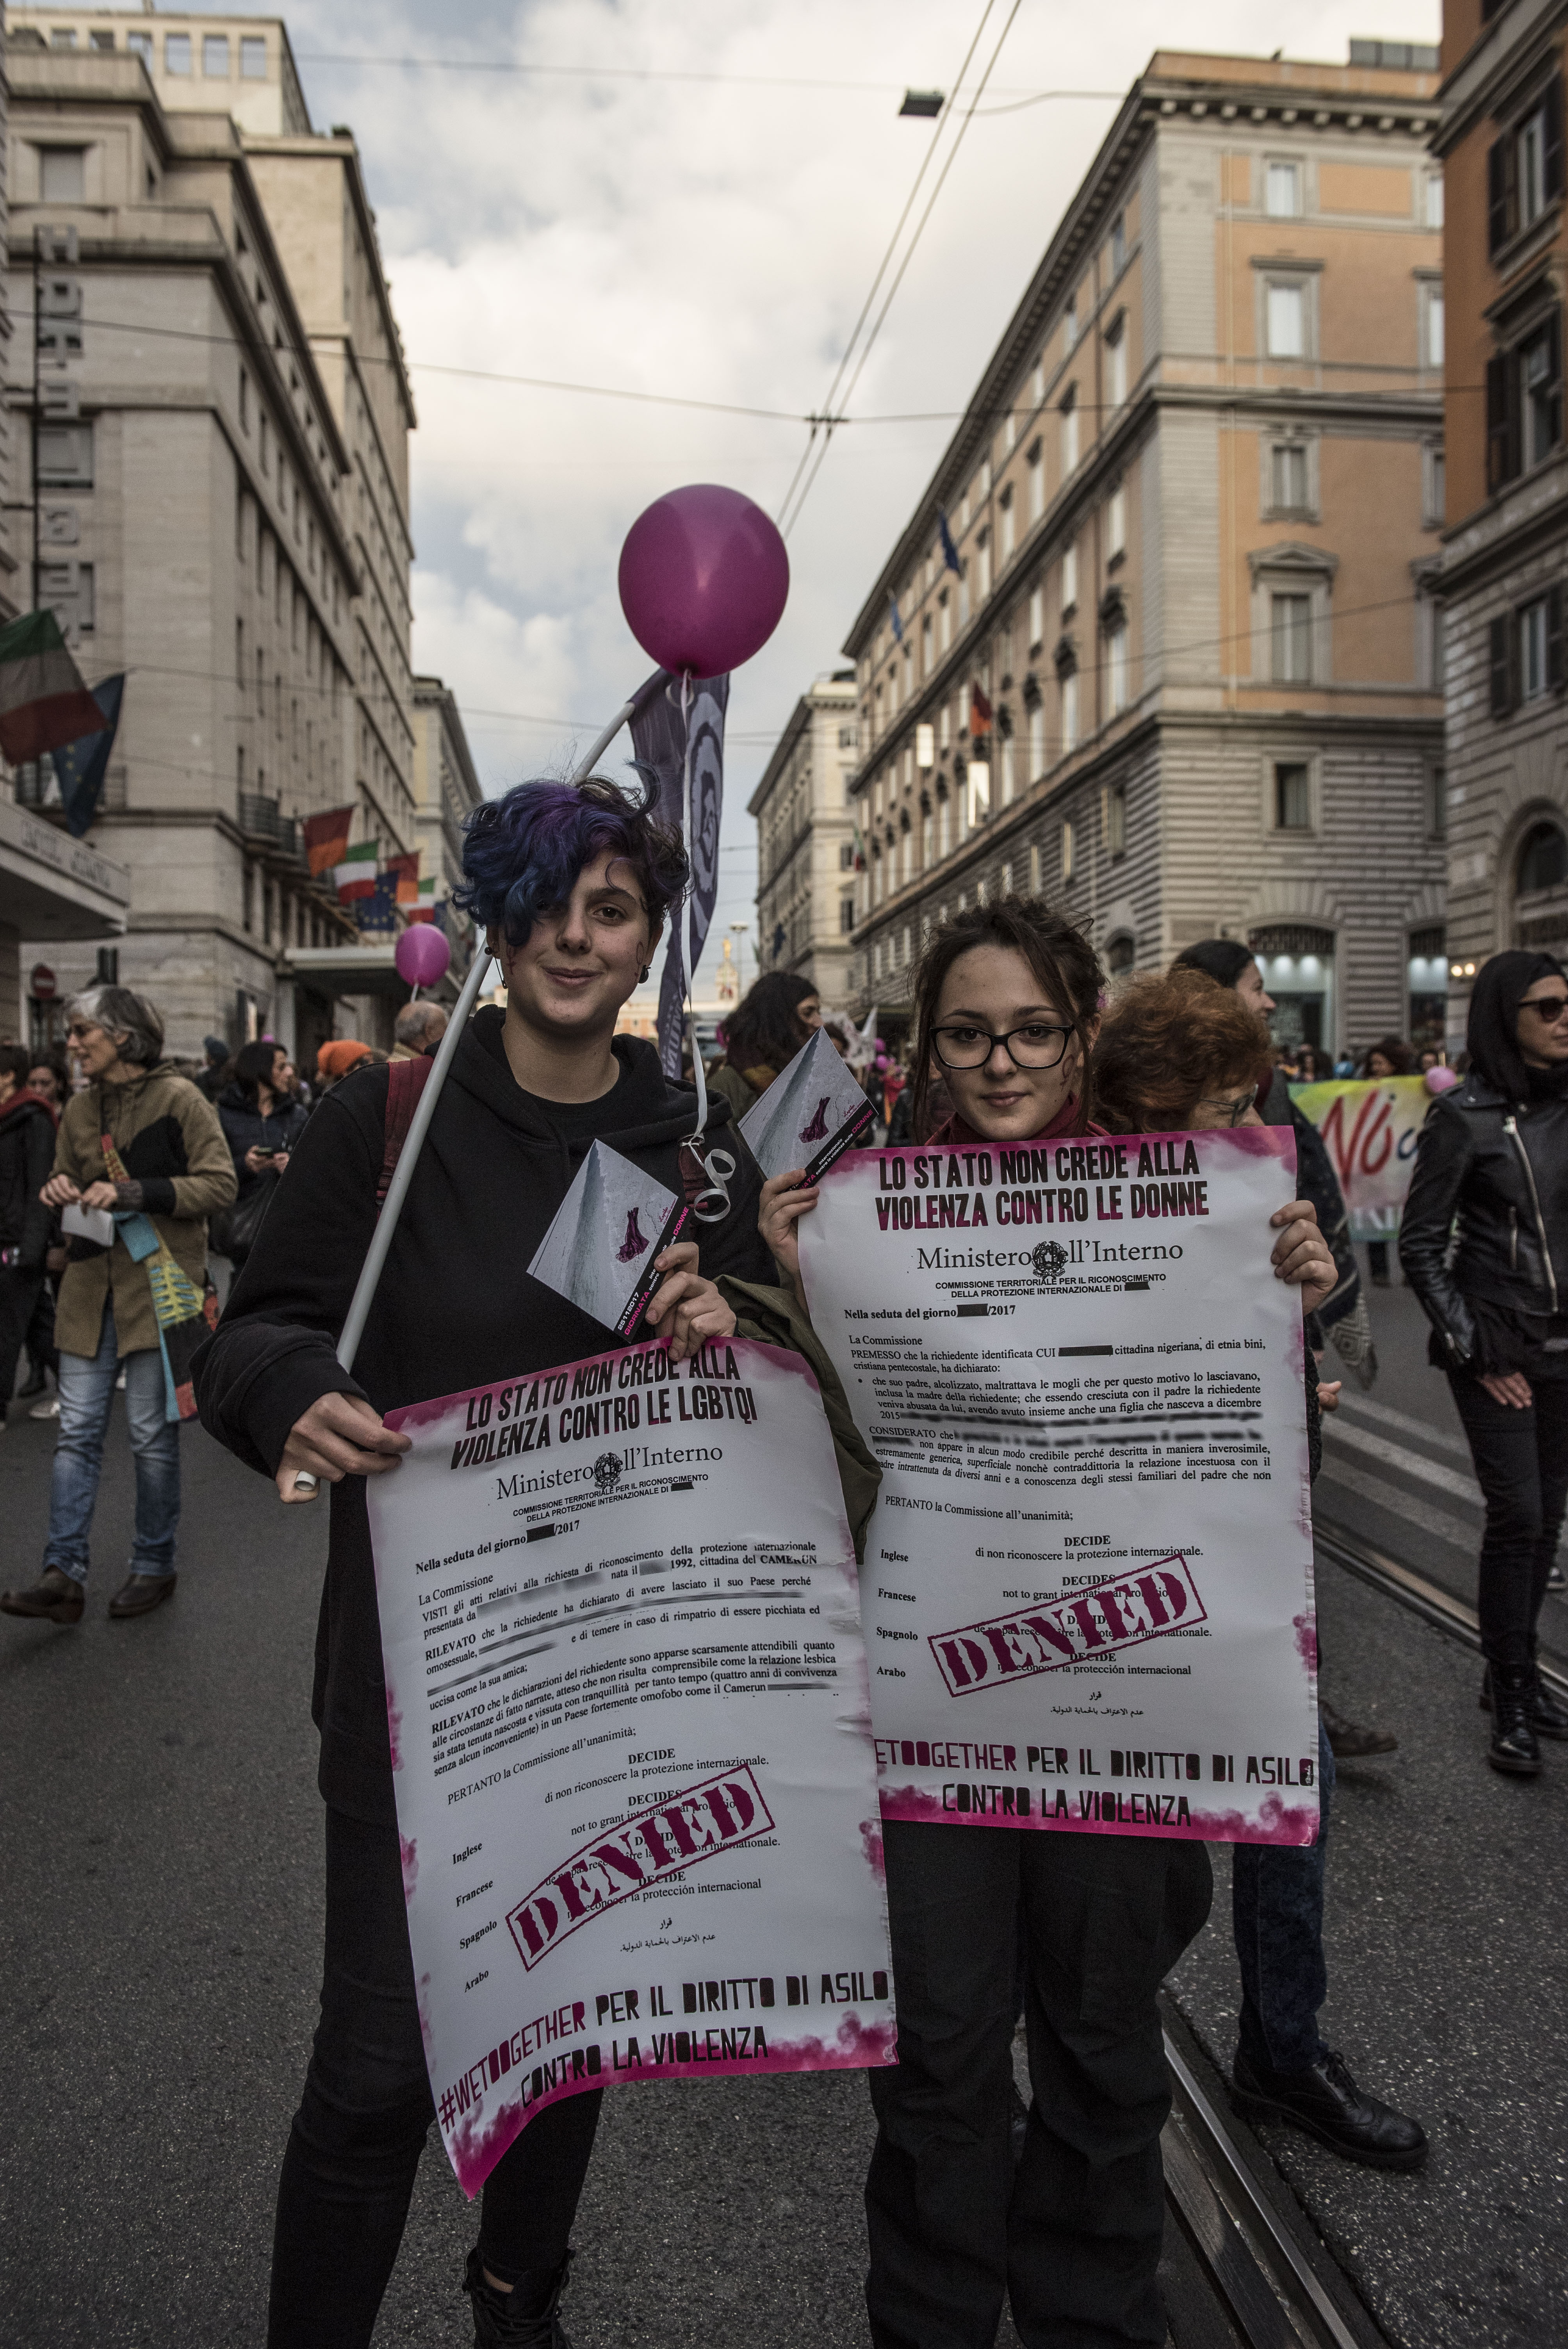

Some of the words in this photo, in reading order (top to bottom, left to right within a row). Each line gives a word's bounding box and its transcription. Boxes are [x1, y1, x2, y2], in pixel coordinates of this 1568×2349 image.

[816, 1161, 828, 1175] contro
[831, 1142, 845, 1158] violenza
[845, 1133, 853, 1143] sulle
[852, 1109, 873, 1134] DONNE
[879, 1156, 907, 1191] LO
[914, 1152, 993, 1189] STATO
[1000, 1148, 1049, 1185] NON
[1055, 1144, 1128, 1181] CREDE
[1137, 1140, 1199, 1177] ALLA
[875, 1192, 988, 1231] VIOLENZA
[996, 1187, 1088, 1225] CONTRO
[1097, 1185, 1123, 1221] LE
[1130, 1180, 1209, 1218] DONNE
[624, 1292, 650, 1335] GIORNATA
[649, 1273, 659, 1291] contro
[673, 1207, 689, 1236] DONNE
[917, 1248, 1032, 1269] Ministero
[935, 1281, 994, 1289] COMMISSIONE
[996, 1279, 1057, 1288] TERRITORIALE
[1088, 1274, 1166, 1284] RICONOSCIMENTO
[981, 1289, 1035, 1297] PROTEZIONE
[1037, 1285, 1111, 1295] INTERNAZIONALE
[618, 1292, 639, 1330] 25112017
[844, 1310, 868, 1319] Nella
[871, 1309, 902, 1319] seduta
[905, 1308, 920, 1318] del
[923, 1308, 956, 1320] giorno
[848, 1335, 861, 1344] La
[862, 1335, 923, 1345] Commissione
[851, 1350, 901, 1359] PREMESSO
[904, 1351, 918, 1360] che
[920, 1351, 928, 1360] la
[931, 1351, 978, 1360] richiedente
[982, 1349, 1033, 1359] identificata
[1036, 1348, 1055, 1358] CUI
[1115, 1344, 1155, 1355] cittadina
[1157, 1342, 1202, 1354] nigeriana,
[1205, 1340, 1214, 1349] di
[1218, 1340, 1241, 1349] etnia
[1244, 1339, 1266, 1349] bini,
[466, 1397, 492, 1431] LO
[499, 1372, 568, 1422] STATO
[571, 1358, 615, 1401] NON
[618, 1346, 680, 1388] CREDE
[689, 1345, 741, 1380] ALLA
[451, 1414, 551, 1470] VIOLENZA
[559, 1394, 640, 1442] CONTRO
[647, 1388, 672, 1425] LE
[678, 1385, 757, 1424] LGBTQI
[497, 1466, 593, 1500] Ministero
[513, 1499, 564, 1518] COMMISSIONE
[565, 1487, 614, 1504] TERRITORIALE
[616, 1484, 629, 1492] PER
[639, 1474, 708, 1488] RICONOSCIMENTO
[527, 1511, 550, 1522] DELLA
[552, 1500, 596, 1516] PROTEZIONE
[598, 1487, 659, 1505] INTERNAZIONALE
[886, 1495, 933, 1510] PERTANTO
[935, 1502, 942, 1511] la
[944, 1503, 1003, 1518] Commissione
[1005, 1507, 1074, 1523] all'unanimità;
[975, 1547, 984, 1557] di
[1007, 1550, 1062, 1560] riconoscere
[1066, 1551, 1074, 1559] la
[1077, 1548, 1128, 1561] protezione
[1131, 1546, 1203, 1556] internazionale.
[1064, 1535, 1111, 1546] DECIDE
[415, 1559, 440, 1574] Nella
[444, 1550, 474, 1565] seduta
[477, 1542, 491, 1555] del
[494, 1536, 526, 1552] giorno
[880, 1549, 909, 1562] Inglese
[419, 1595, 431, 1606] La
[433, 1575, 495, 1600] Commissione
[422, 1606, 447, 1622] VISTI
[454, 1600, 463, 1614] gli
[470, 1596, 482, 1606] atti
[489, 1584, 517, 1600] relativi
[524, 1578, 538, 1589] alla
[544, 1568, 579, 1584] richiesta
[585, 1562, 592, 1572] di
[599, 1550, 663, 1569] riconoscimento
[670, 1545, 693, 1556] della
[700, 1542, 747, 1555] protezione
[1062, 1574, 1115, 1586] DECIDES
[878, 1588, 916, 1602] Francese
[1033, 1591, 1057, 1600] grant
[877, 1627, 918, 1641] Spagnolo
[938, 1571, 1187, 1688] DENIED
[877, 1666, 906, 1677] Arabo
[1074, 1665, 1124, 1675] protección
[1128, 1665, 1191, 1674] internacional
[448, 1772, 501, 1805] PERTANTO
[504, 1769, 511, 1779] la
[513, 1746, 569, 1773] Commissione
[572, 1727, 636, 1751] all'unanimità;
[628, 1748, 675, 1764] DECIDE
[1027, 1747, 1068, 1774] PER
[1079, 1748, 1101, 1775] IL
[1110, 1750, 1200, 1781] DIRITTO
[1212, 1754, 1235, 1783] DI
[1246, 1756, 1313, 1786] ASILO
[545, 1793, 553, 1804] di
[556, 1788, 572, 1799] non
[574, 1773, 627, 1793] riconoscere
[630, 1769, 639, 1778] la
[642, 1762, 693, 1779] protezione
[697, 1756, 769, 1770] internazionale.
[628, 1789, 682, 1806] DECIDES
[942, 1784, 1031, 1816] CONTRO
[1041, 1788, 1068, 1820] LA
[1079, 1790, 1191, 1827] VIOLENZA
[571, 1824, 585, 1835] not
[600, 1814, 624, 1829] grant
[453, 1843, 482, 1864] Inglese
[514, 1783, 754, 1959] DENIED
[456, 1880, 493, 1907] Francese
[631, 1893, 640, 1902] la
[643, 1885, 695, 1902] protección
[698, 1878, 761, 1893] internacional
[460, 1921, 497, 1949] Spagnolo
[465, 1971, 489, 1993] Arabo
[438, 2001, 585, 2134] #WETOOGETHER
[595, 1989, 639, 2025] PER
[650, 1985, 673, 2017] IL
[683, 1977, 775, 2013] DIRITTO
[786, 1975, 809, 2006] DI
[821, 1971, 888, 2003] ASILO
[521, 2044, 601, 2108] CONTRO
[612, 2036, 641, 2071] LA
[652, 2025, 768, 2065] VIOLENZA
